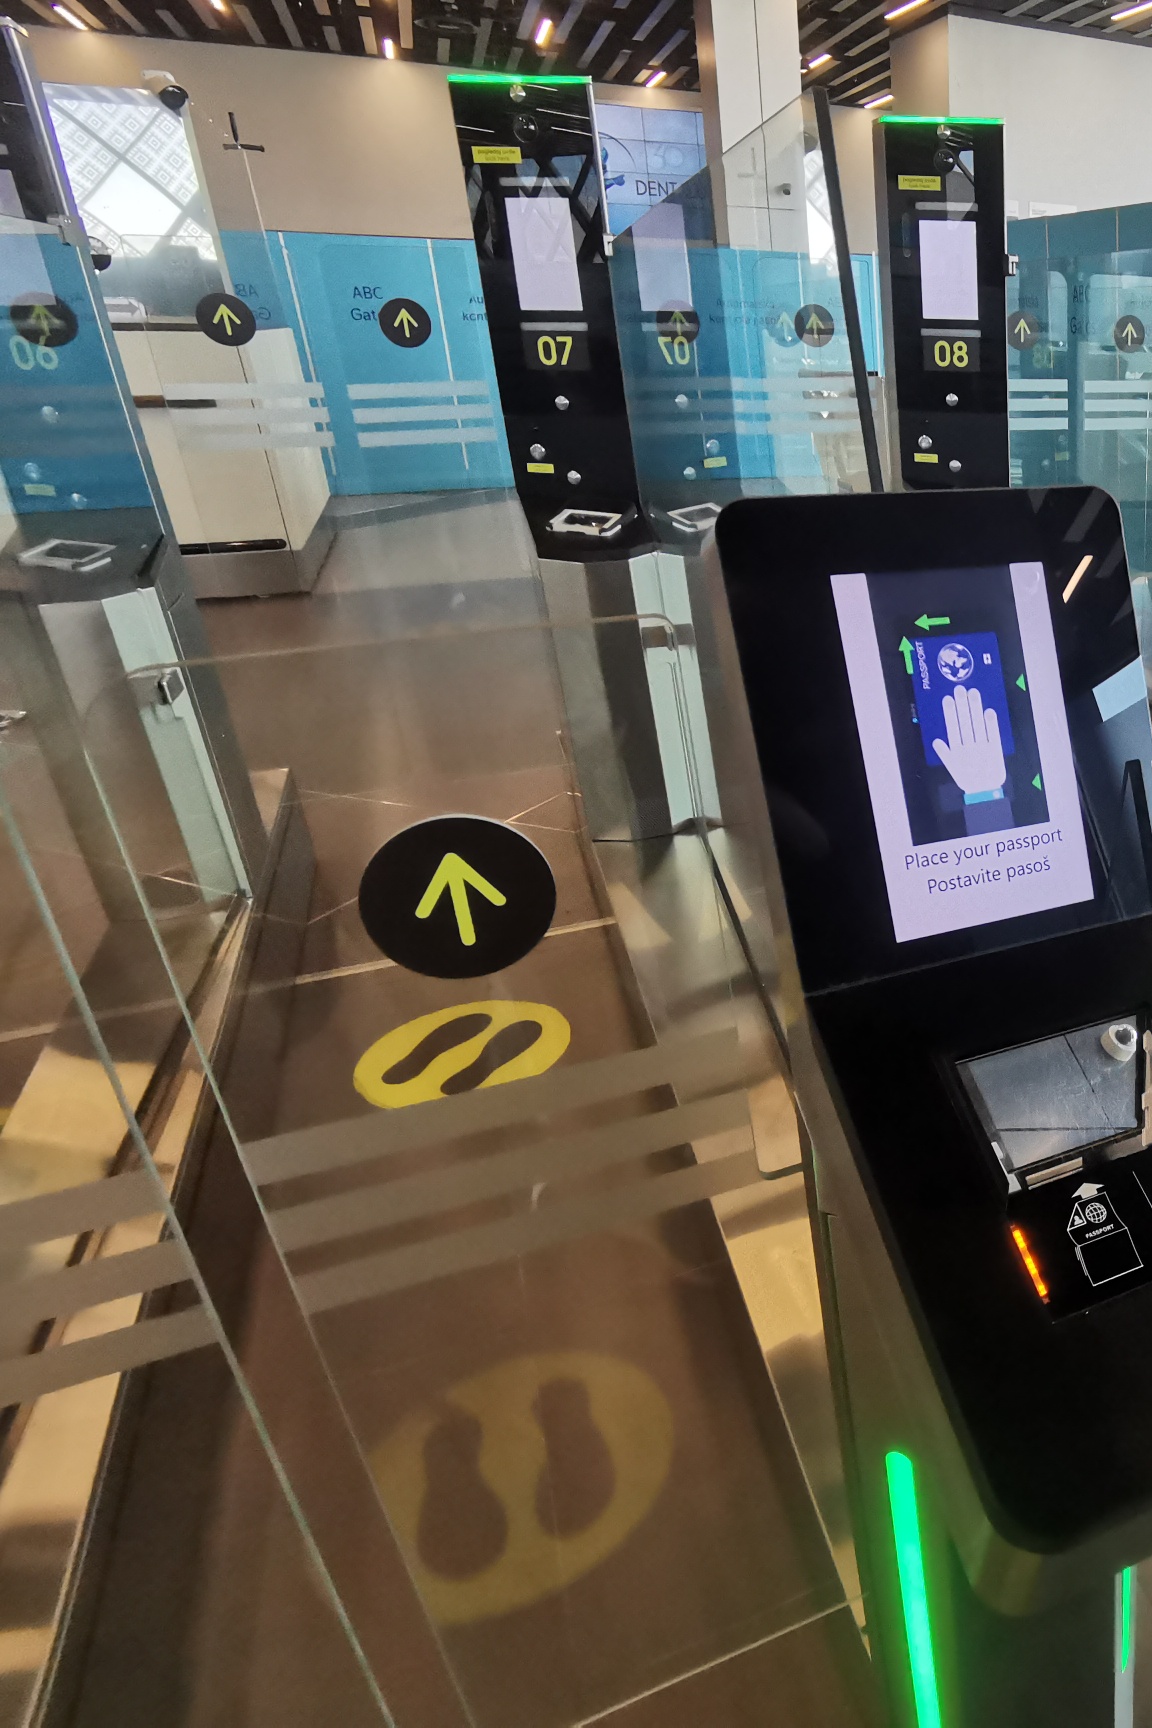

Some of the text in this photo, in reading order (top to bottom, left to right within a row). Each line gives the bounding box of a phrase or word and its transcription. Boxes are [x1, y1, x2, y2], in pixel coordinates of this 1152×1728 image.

[353, 286, 383, 299] ABC
[351, 307, 378, 321] Gat
[537, 335, 573, 366] 07
[934, 340, 969, 368] 08
[915, 640, 931, 690] PASSPORT
[904, 828, 1063, 870] Place your passport
[927, 855, 1051, 894] Postavite pasoš
[1085, 1223, 1115, 1239] PASSPORT
